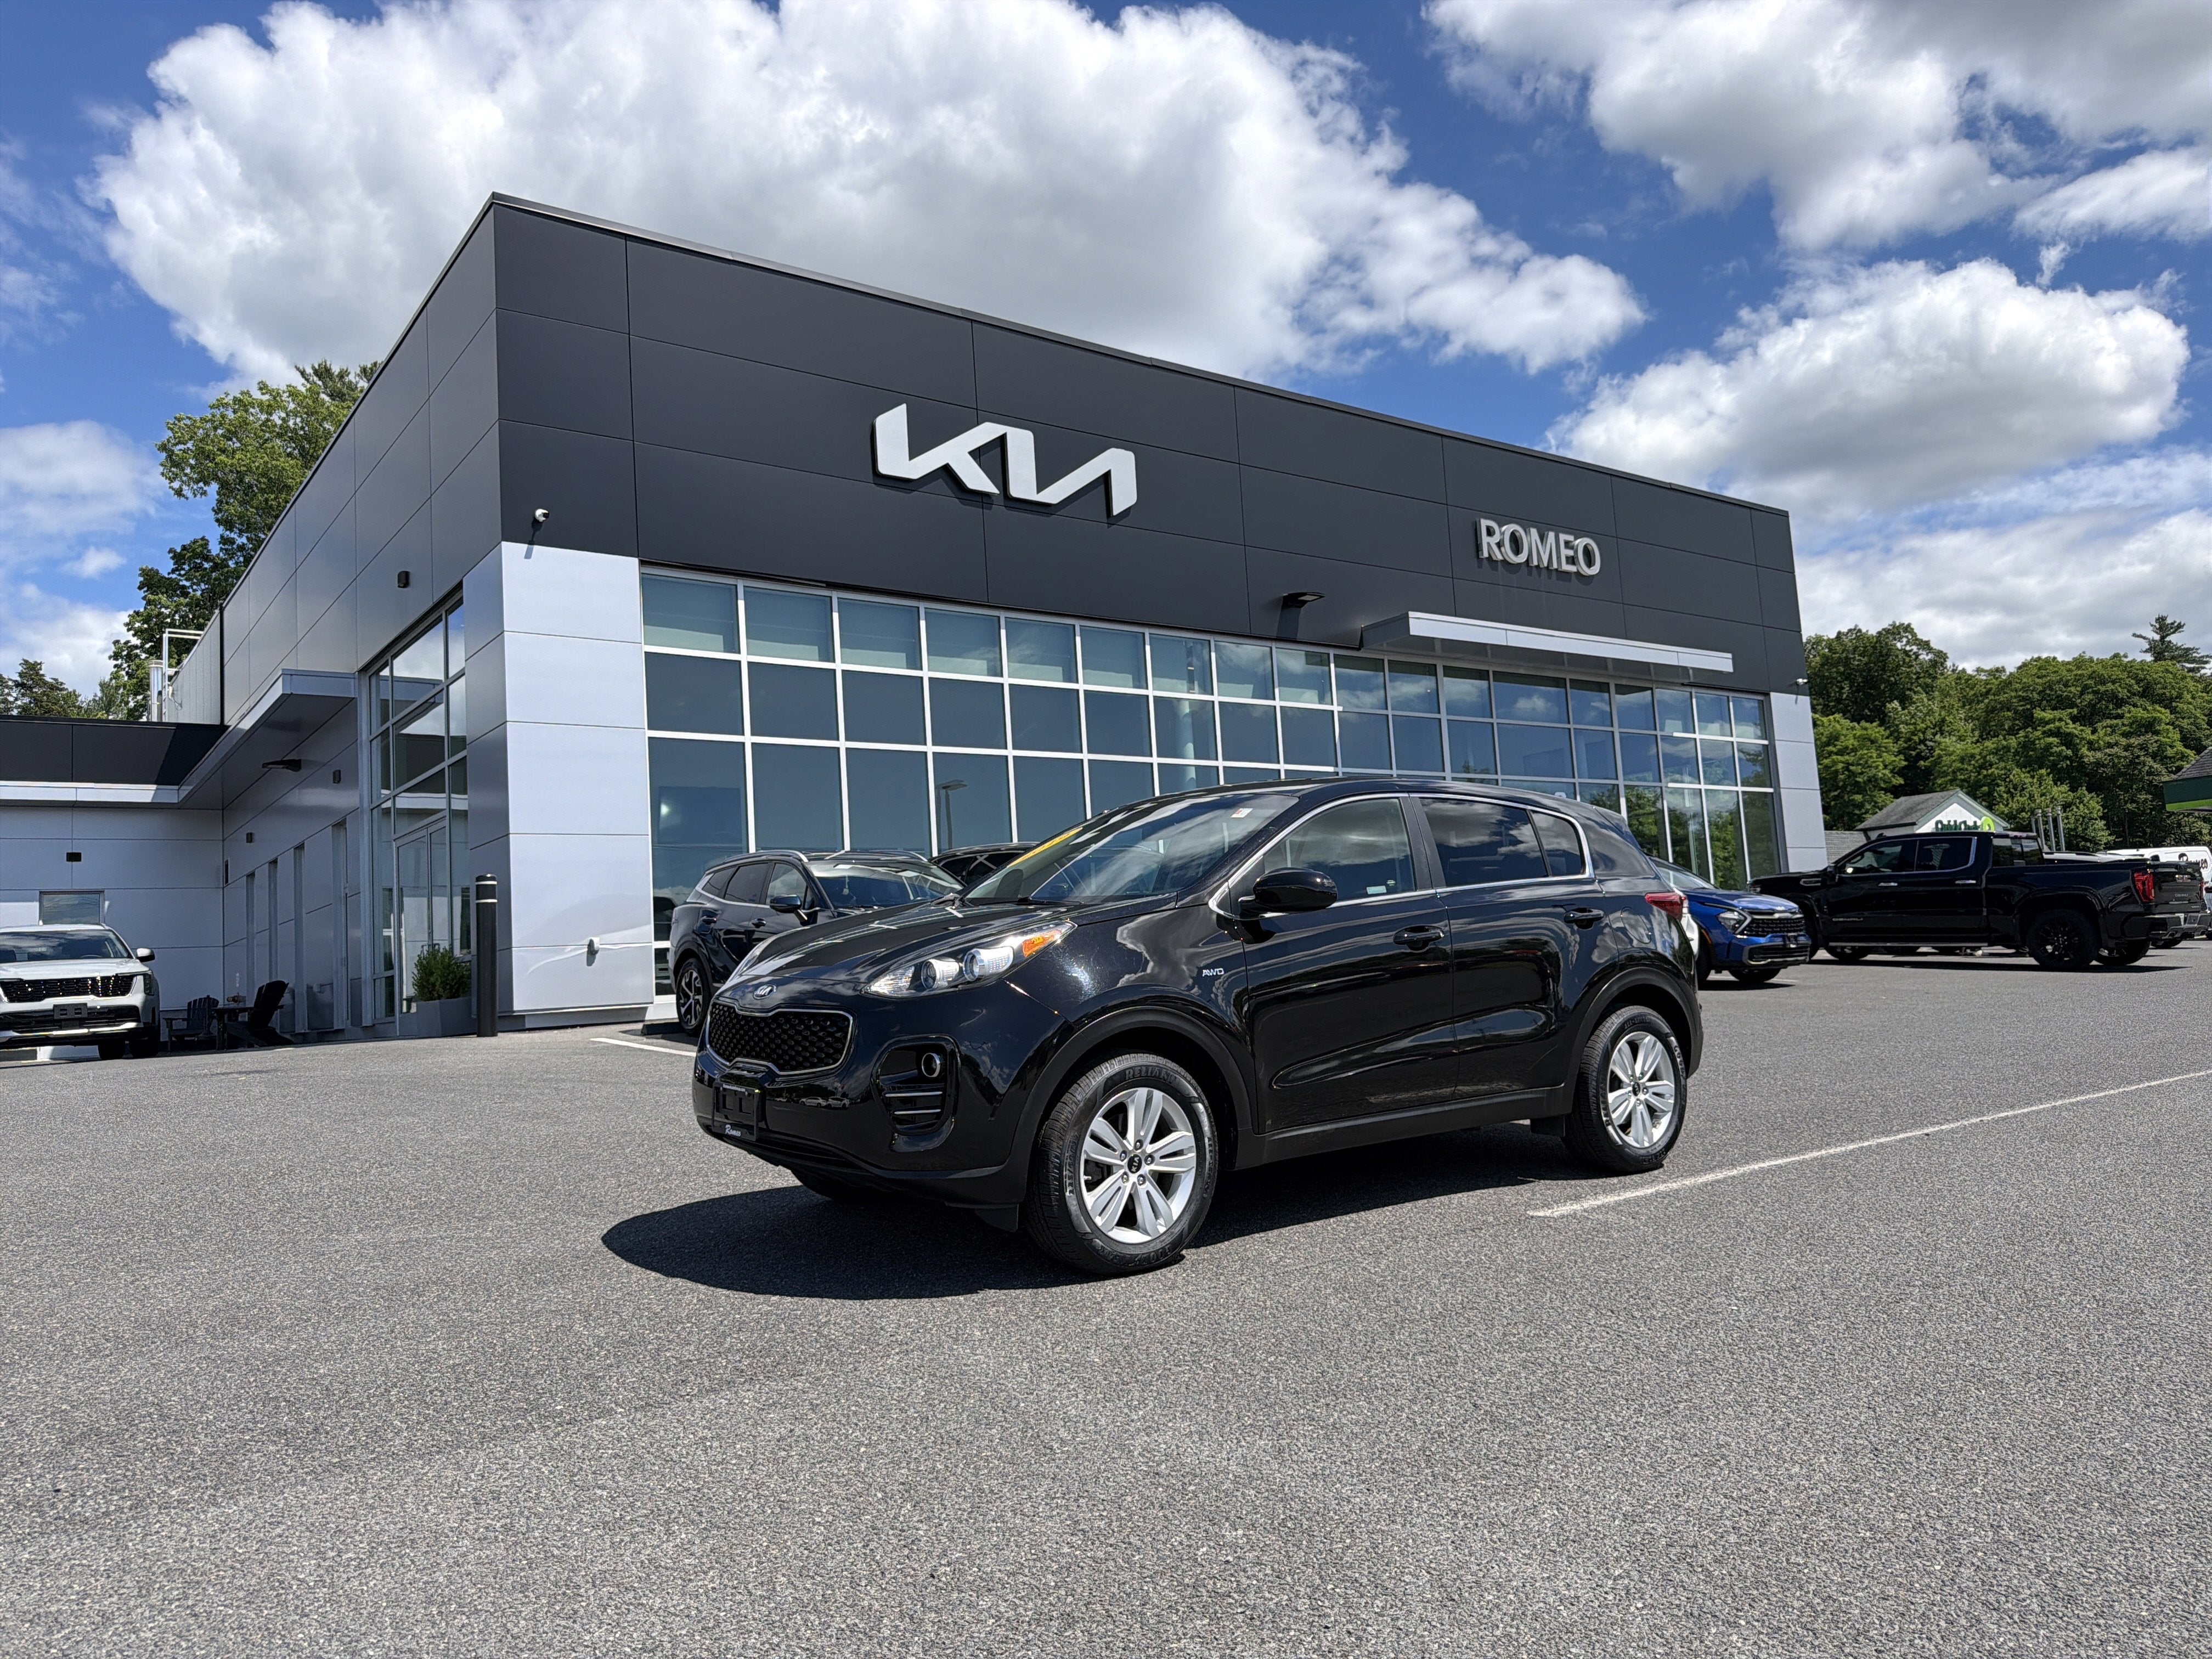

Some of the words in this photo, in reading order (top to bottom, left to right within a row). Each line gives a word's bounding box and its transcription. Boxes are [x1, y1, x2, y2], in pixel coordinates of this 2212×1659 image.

[874, 403, 1137, 517] KIA
[1476, 518, 1601, 576] ROMEO
[1202, 968, 1224, 977] AWD
